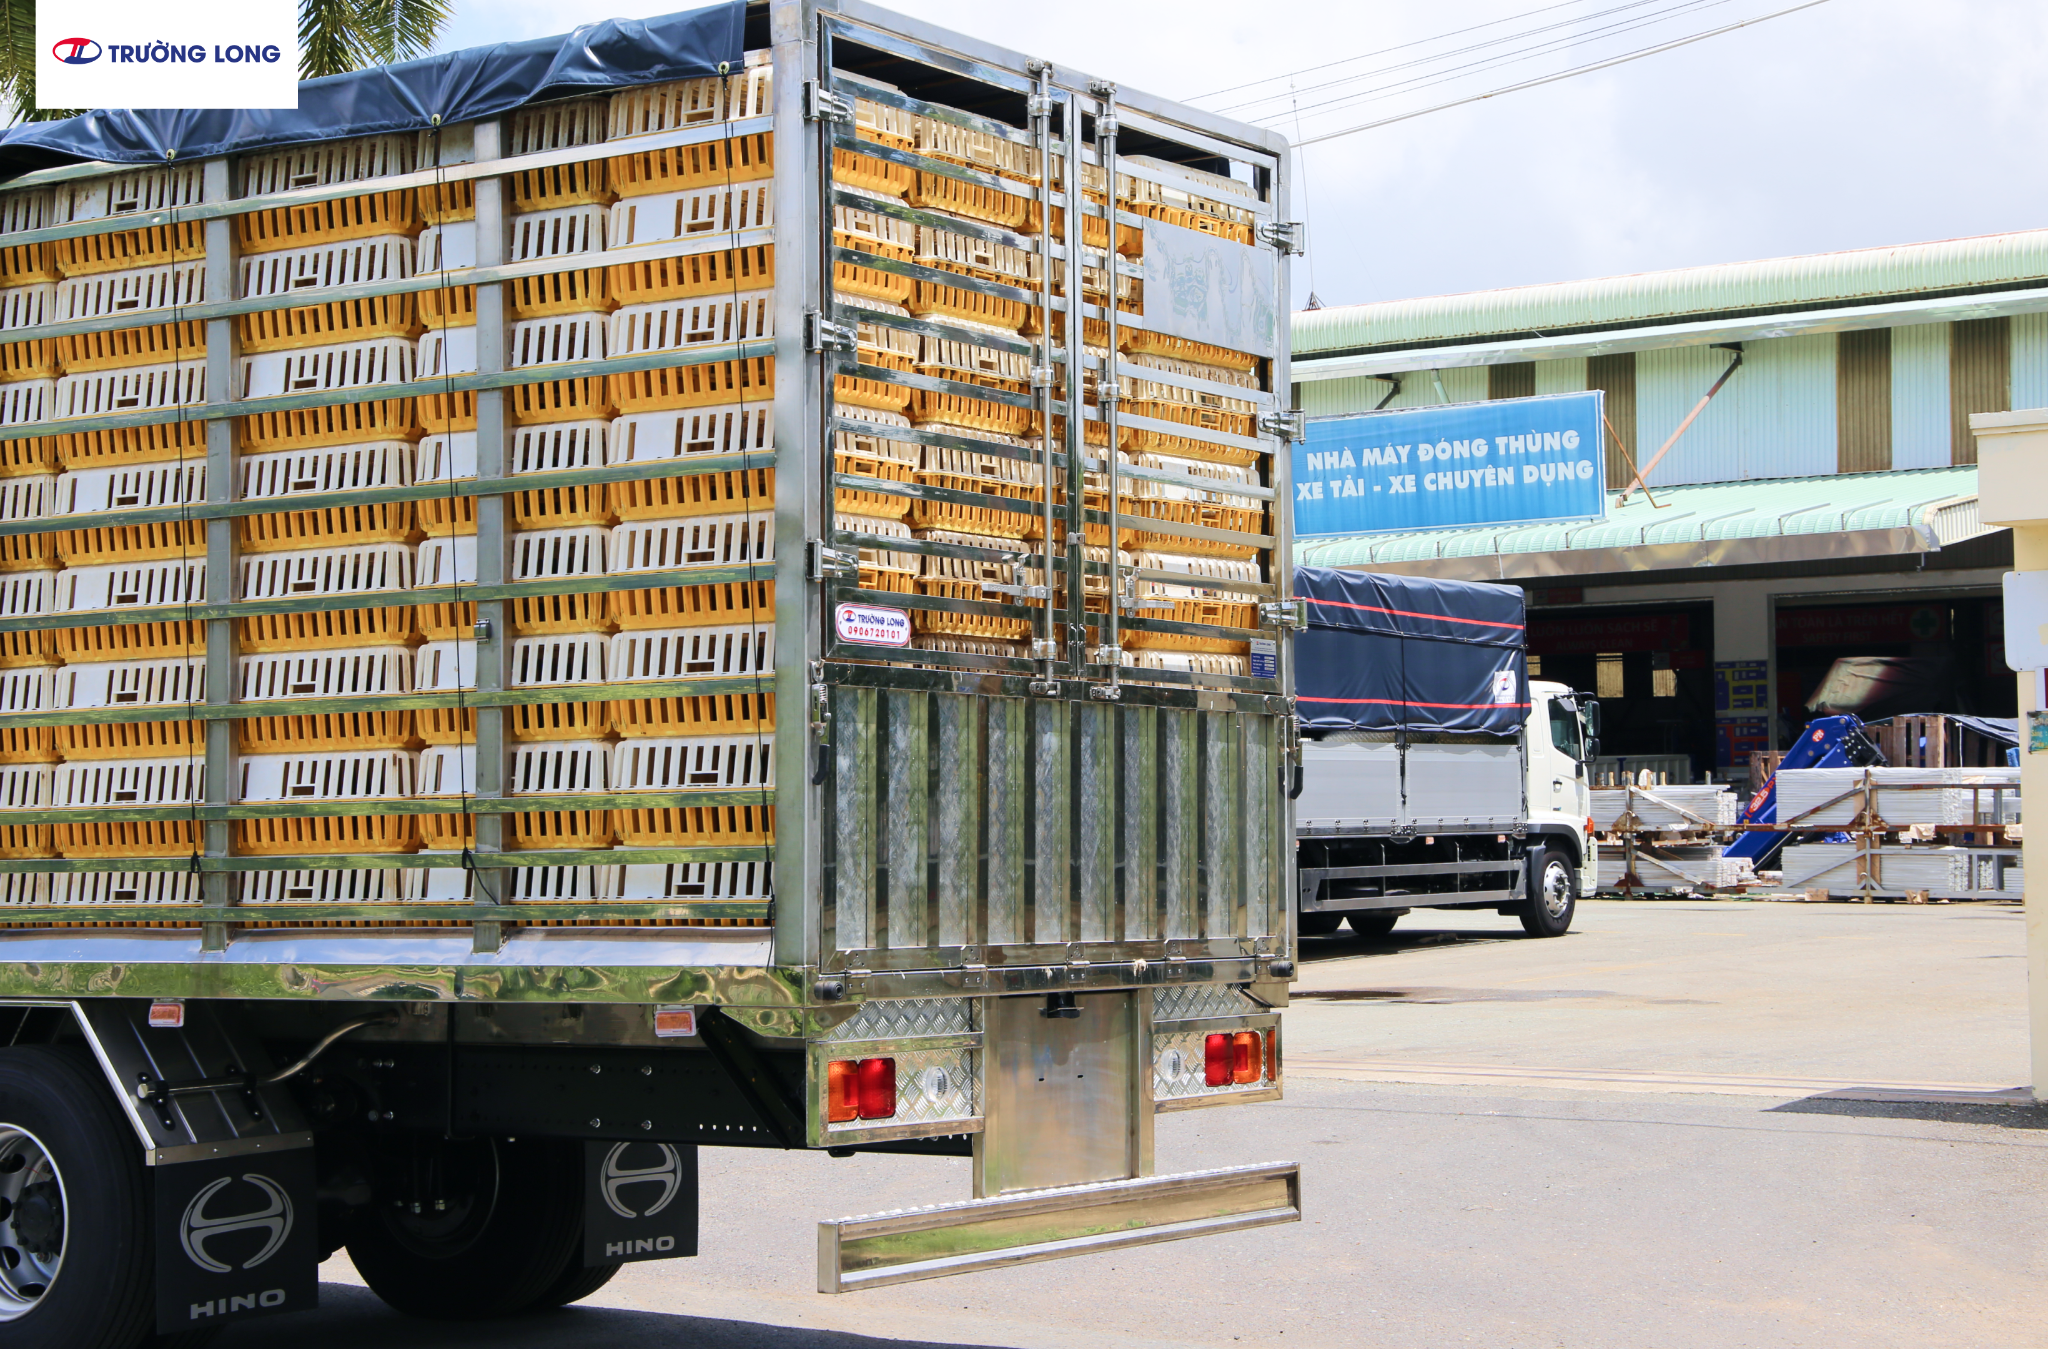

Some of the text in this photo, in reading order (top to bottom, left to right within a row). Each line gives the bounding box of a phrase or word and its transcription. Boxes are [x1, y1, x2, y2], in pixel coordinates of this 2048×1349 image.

[1306, 429, 1580, 471] NHÀ MÁY ĐÓNG THÙNG
[1296, 459, 1594, 501] XE TẢI - XE CHUYÊN DỤNG
[858, 613, 905, 627] TRƯỜNG LONG
[1531, 623, 1564, 637] LUÔN
[1569, 621, 1604, 636] LUÔN
[1607, 621, 1640, 636] SẠCH
[1791, 614, 1825, 629] TOÀN
[1828, 613, 1843, 627] LÀ
[1845, 612, 1878, 627] TRÊN
[1881, 610, 1905, 626] HẾT
[848, 626, 900, 639] 0906720101
[1802, 630, 1872, 644] SAFETY FIRST
[1556, 638, 1633, 651] ALWAYS CLEAN
[1750, 789, 1769, 812] 32.5
[606, 1235, 675, 1257] HINO
[190, 1288, 286, 1320] HINO
